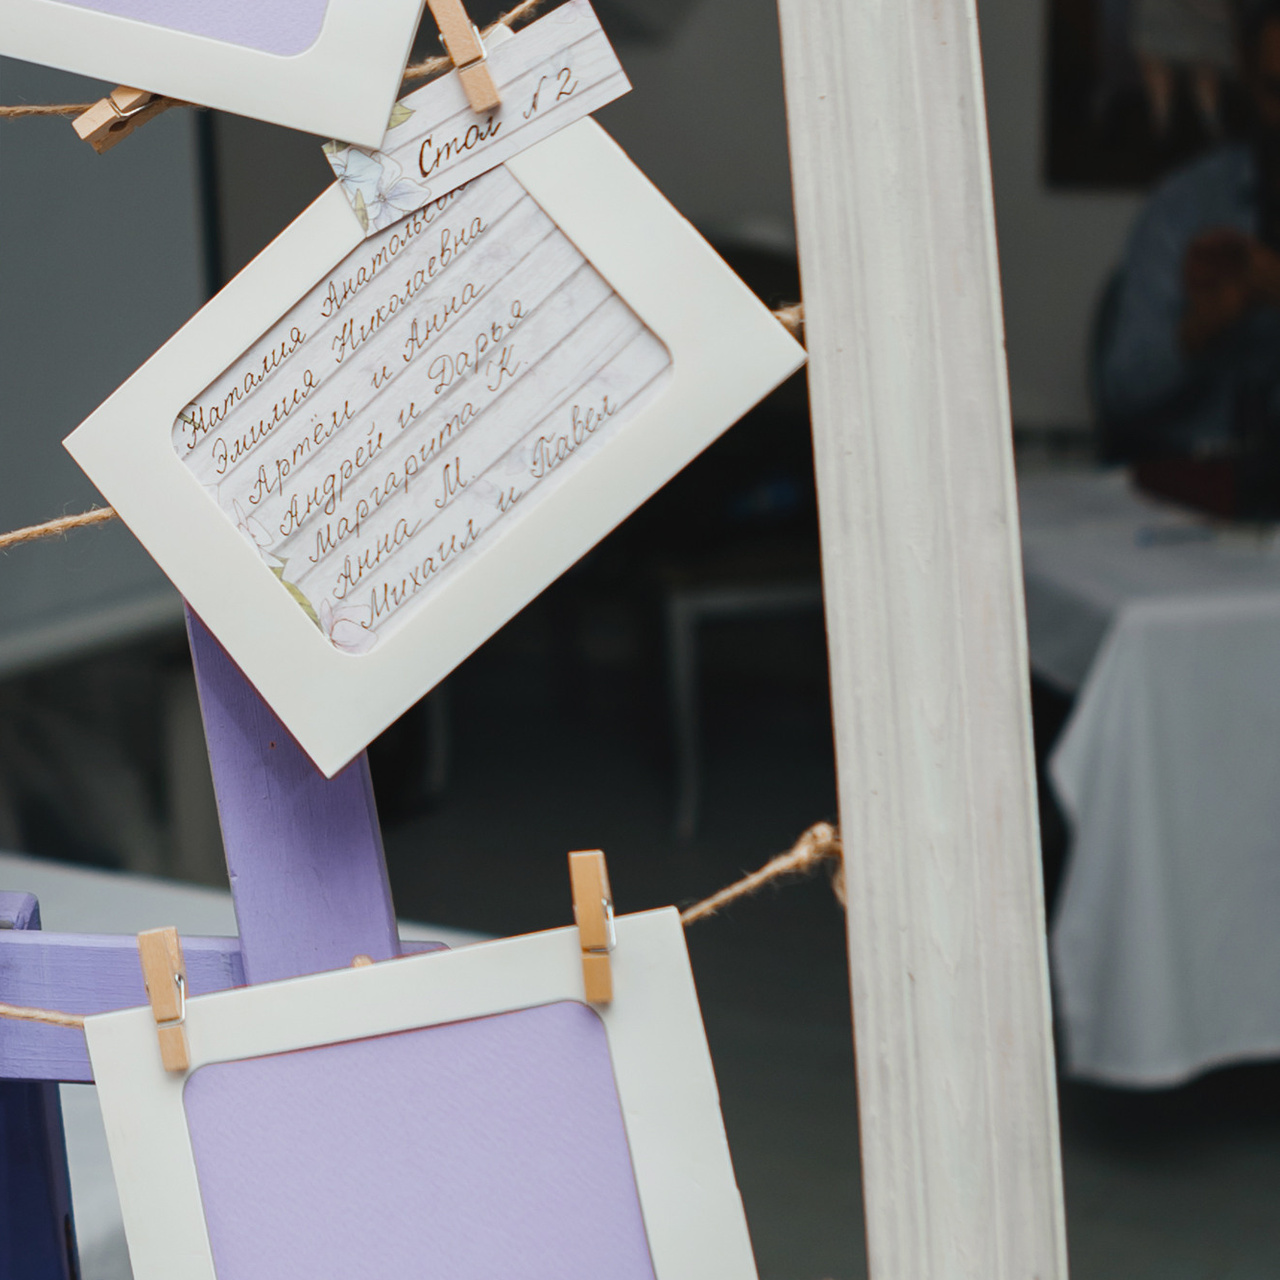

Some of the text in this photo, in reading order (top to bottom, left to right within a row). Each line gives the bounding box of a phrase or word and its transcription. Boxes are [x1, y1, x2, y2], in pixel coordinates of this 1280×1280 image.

[418, 116, 502, 178] Стол
[555, 67, 579, 101] 2
[181, 183, 468, 450] Наталия Анатолье
[212, 217, 489, 475] Эмилия Николаевна
[248, 282, 486, 505] Артём и Анна
[279, 299, 528, 536] Андрей и Дарья
[308, 402, 481, 563] Маргарита
[332, 518, 422, 600] Анна
[360, 395, 617, 630] Михаил и Павел
